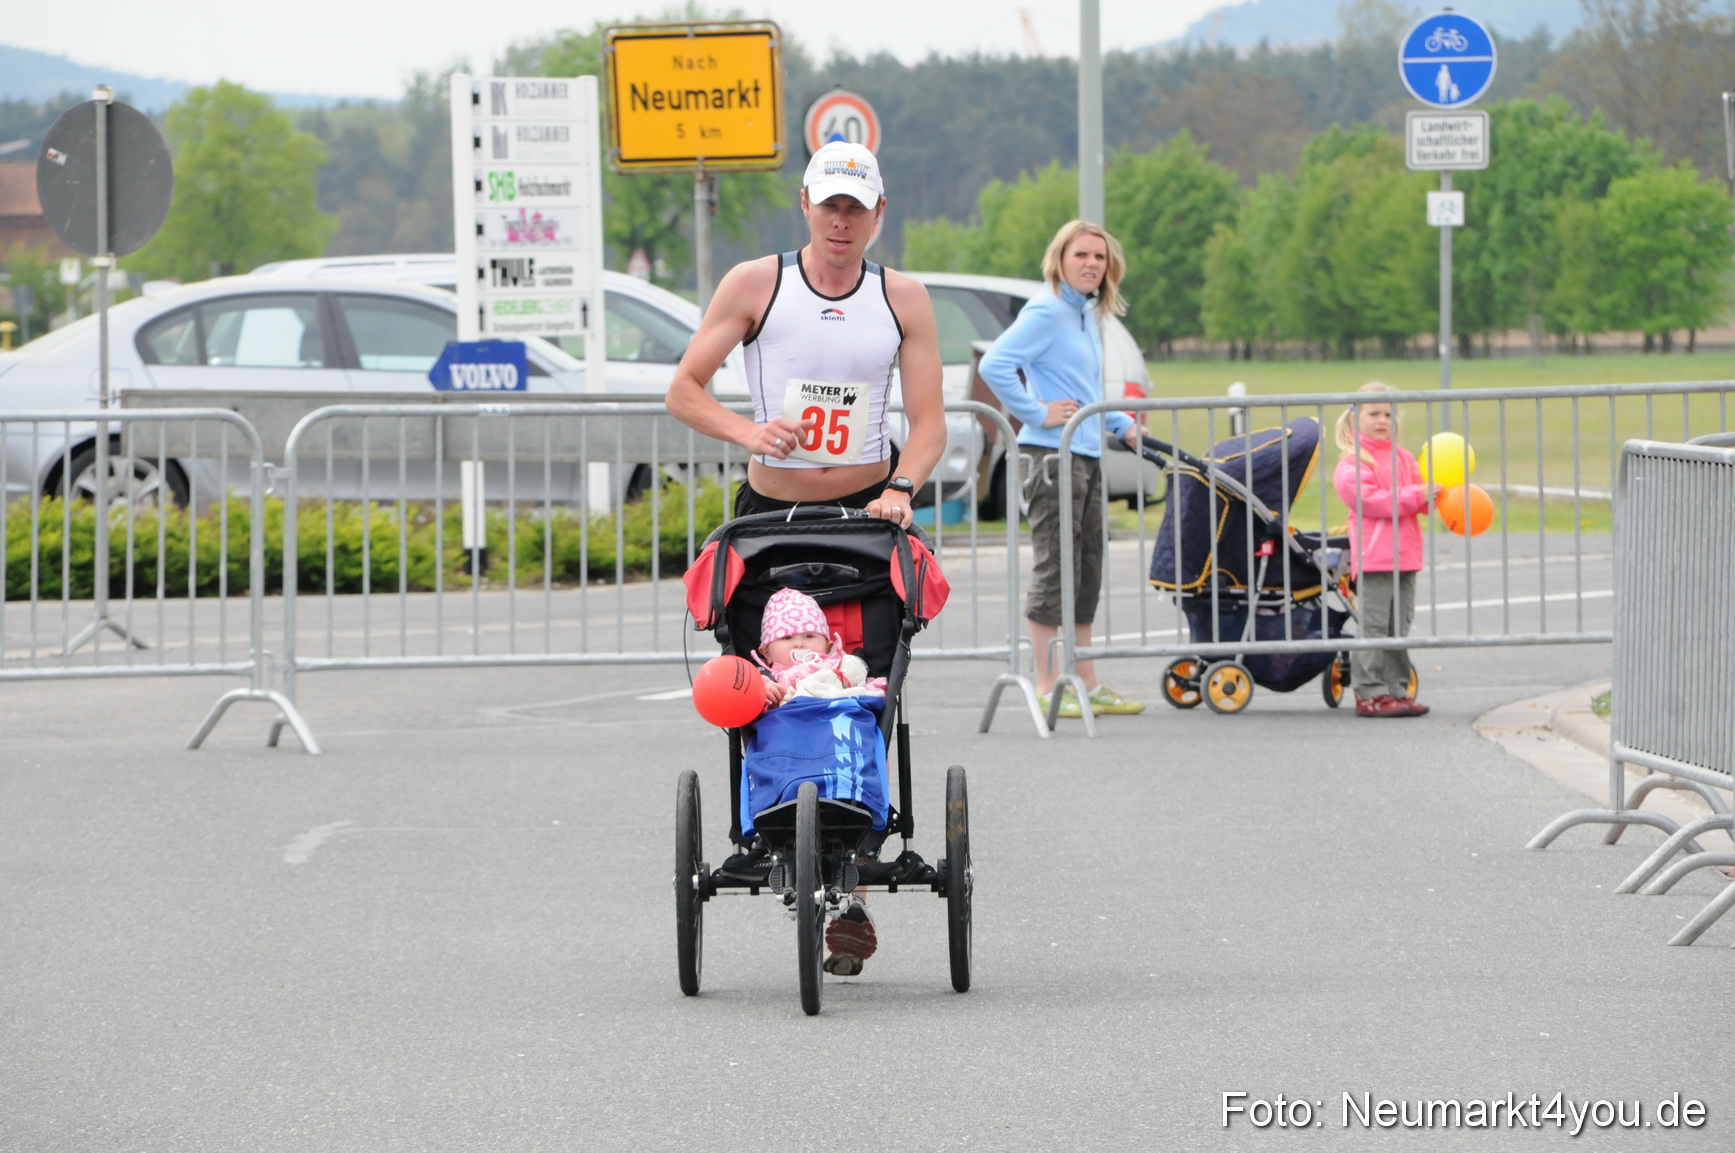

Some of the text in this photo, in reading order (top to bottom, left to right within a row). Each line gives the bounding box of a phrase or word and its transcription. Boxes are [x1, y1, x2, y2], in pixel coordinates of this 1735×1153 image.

[672, 55, 718, 70] Nach
[630, 79, 761, 112] Neumarkt
[676, 123, 723, 139] 5 km
[1415, 148, 1480, 161] Verkehr frei
[448, 363, 519, 390] VOLVO
[801, 383, 841, 396] MEYER
[800, 393, 841, 404] WERBUNG
